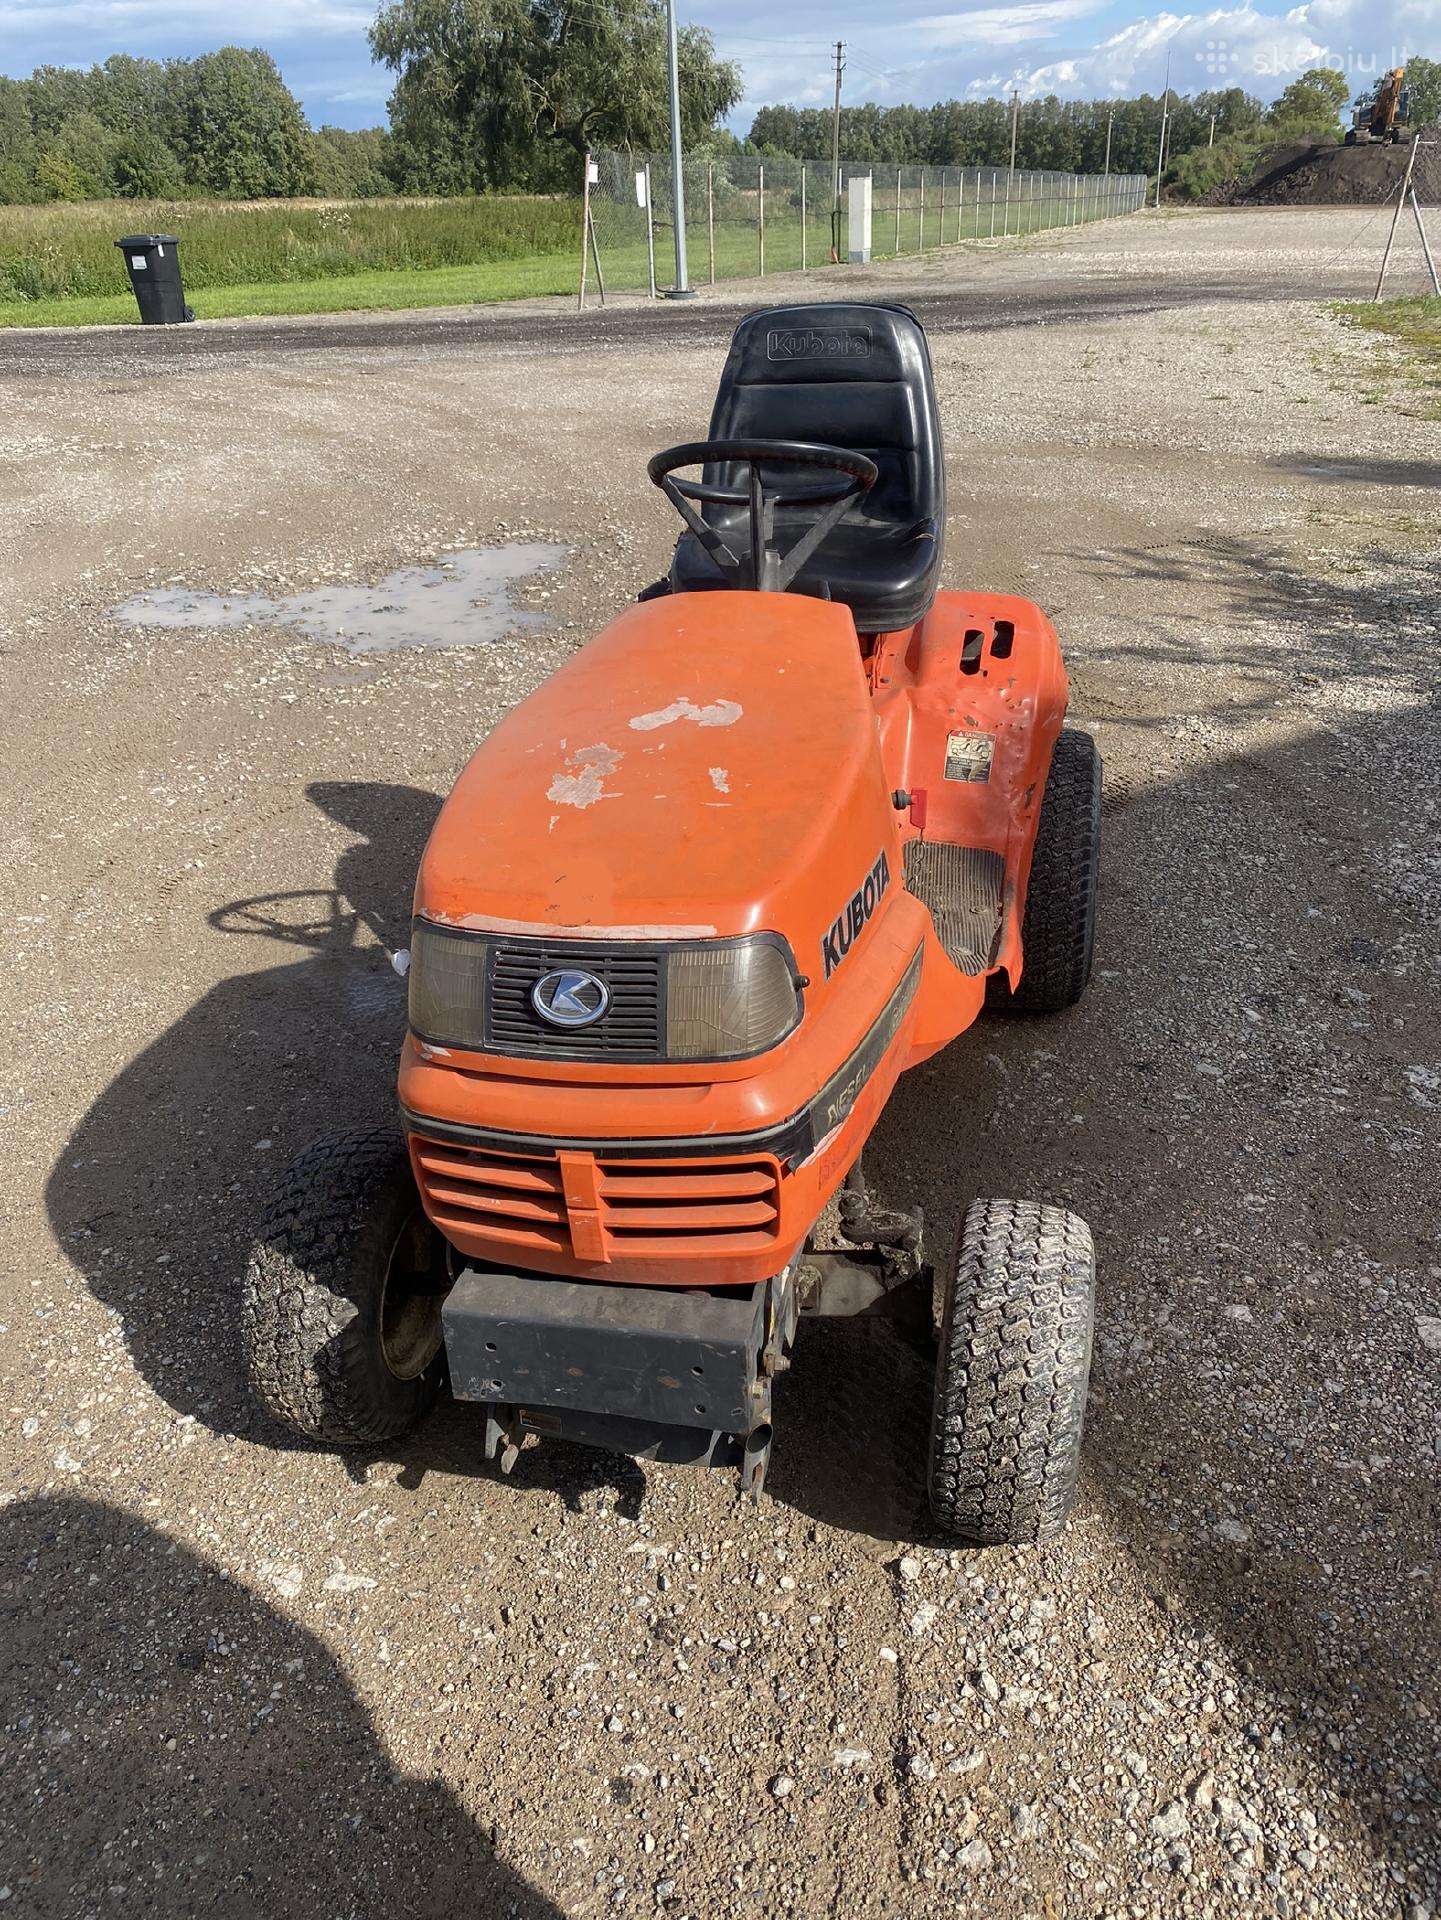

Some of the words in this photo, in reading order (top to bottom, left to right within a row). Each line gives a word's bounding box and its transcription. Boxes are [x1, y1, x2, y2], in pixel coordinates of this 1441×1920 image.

[770, 331, 867, 356] Kubota
[822, 849, 891, 981] KUBOTA
[827, 1064, 869, 1127] DIESEL
